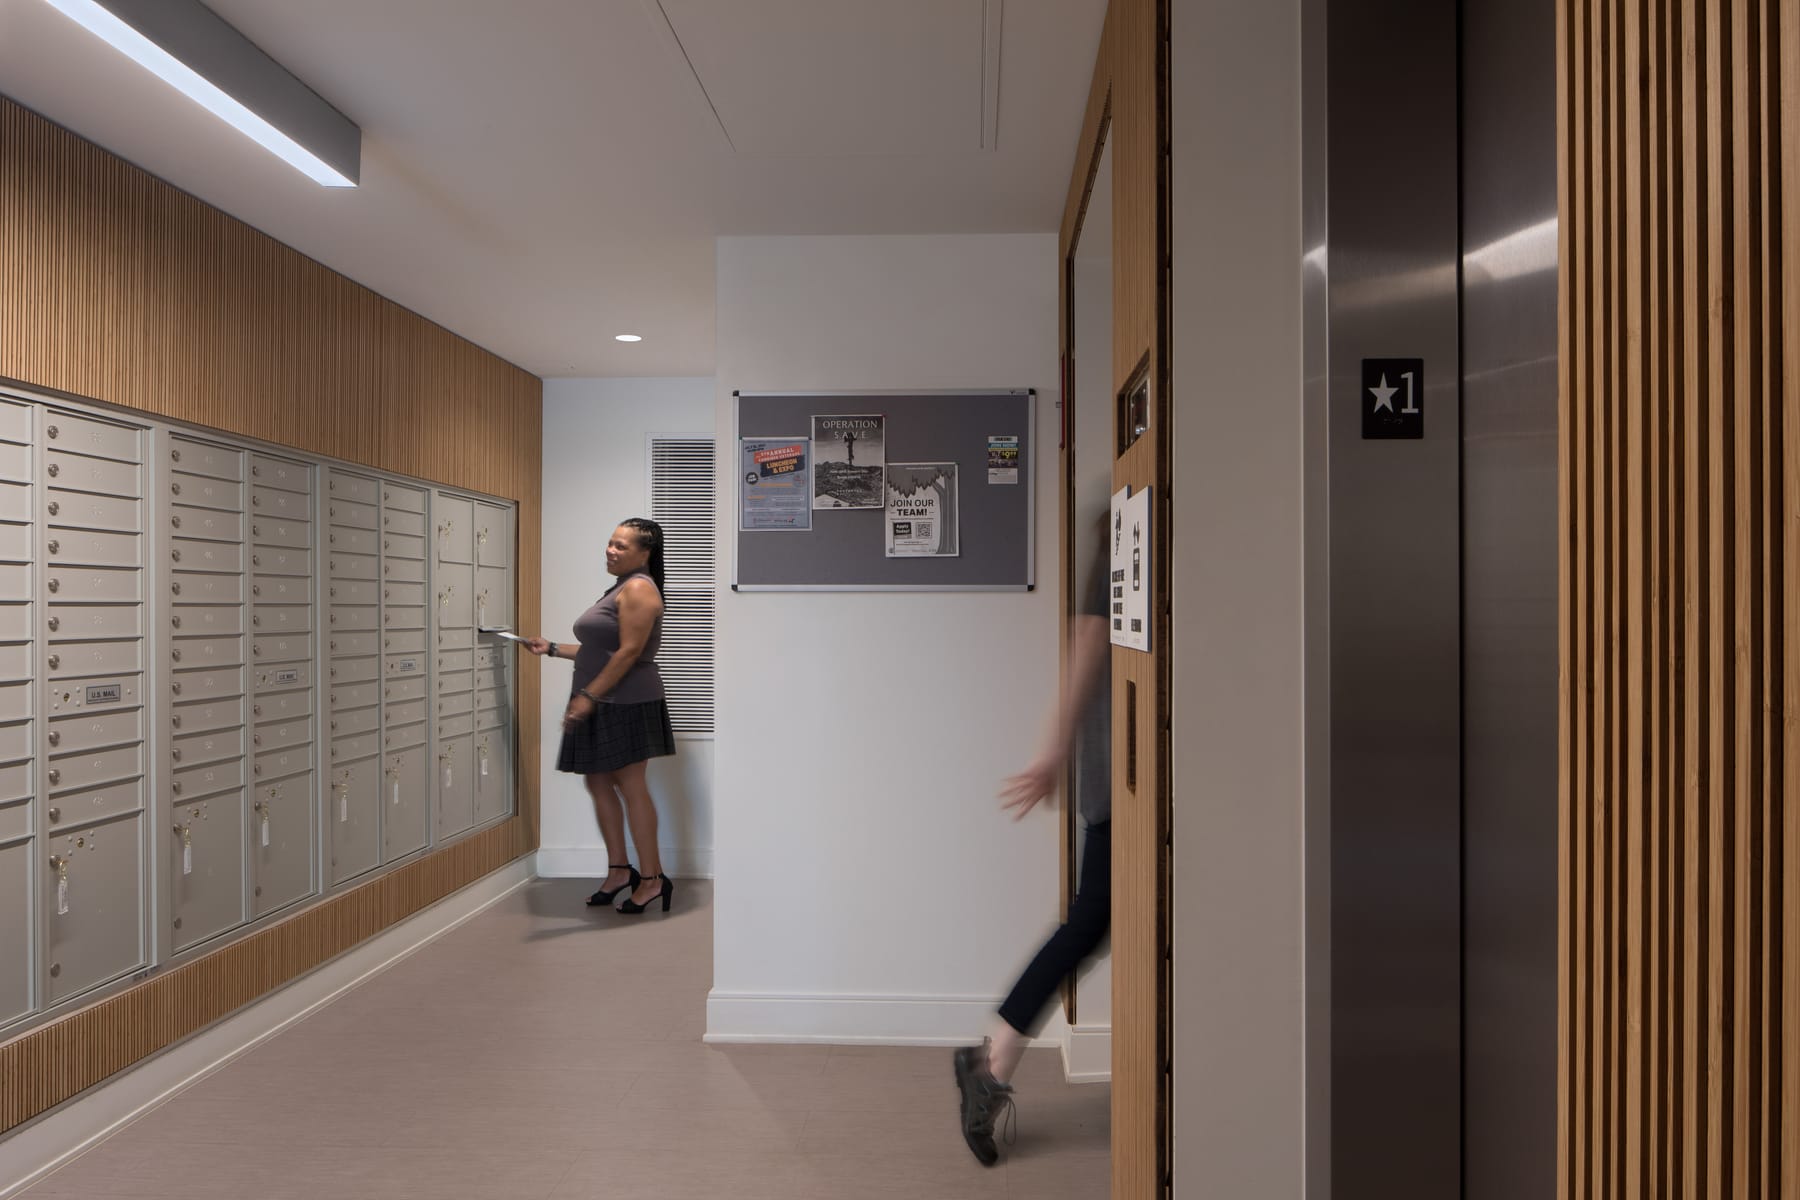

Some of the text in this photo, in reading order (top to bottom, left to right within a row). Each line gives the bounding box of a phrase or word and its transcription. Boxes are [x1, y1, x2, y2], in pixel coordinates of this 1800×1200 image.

[1400, 371, 1419, 414] 1
[822, 420, 878, 429] OPERATION
[770, 447, 794, 456] ANNUAL
[766, 458, 798, 469] LUNCHEON
[779, 465, 795, 473] EXPO
[890, 499, 934, 507] JOIN OUR
[896, 508, 928, 516] TEAM!
[91, 689, 116, 698] U.S. MAIL
